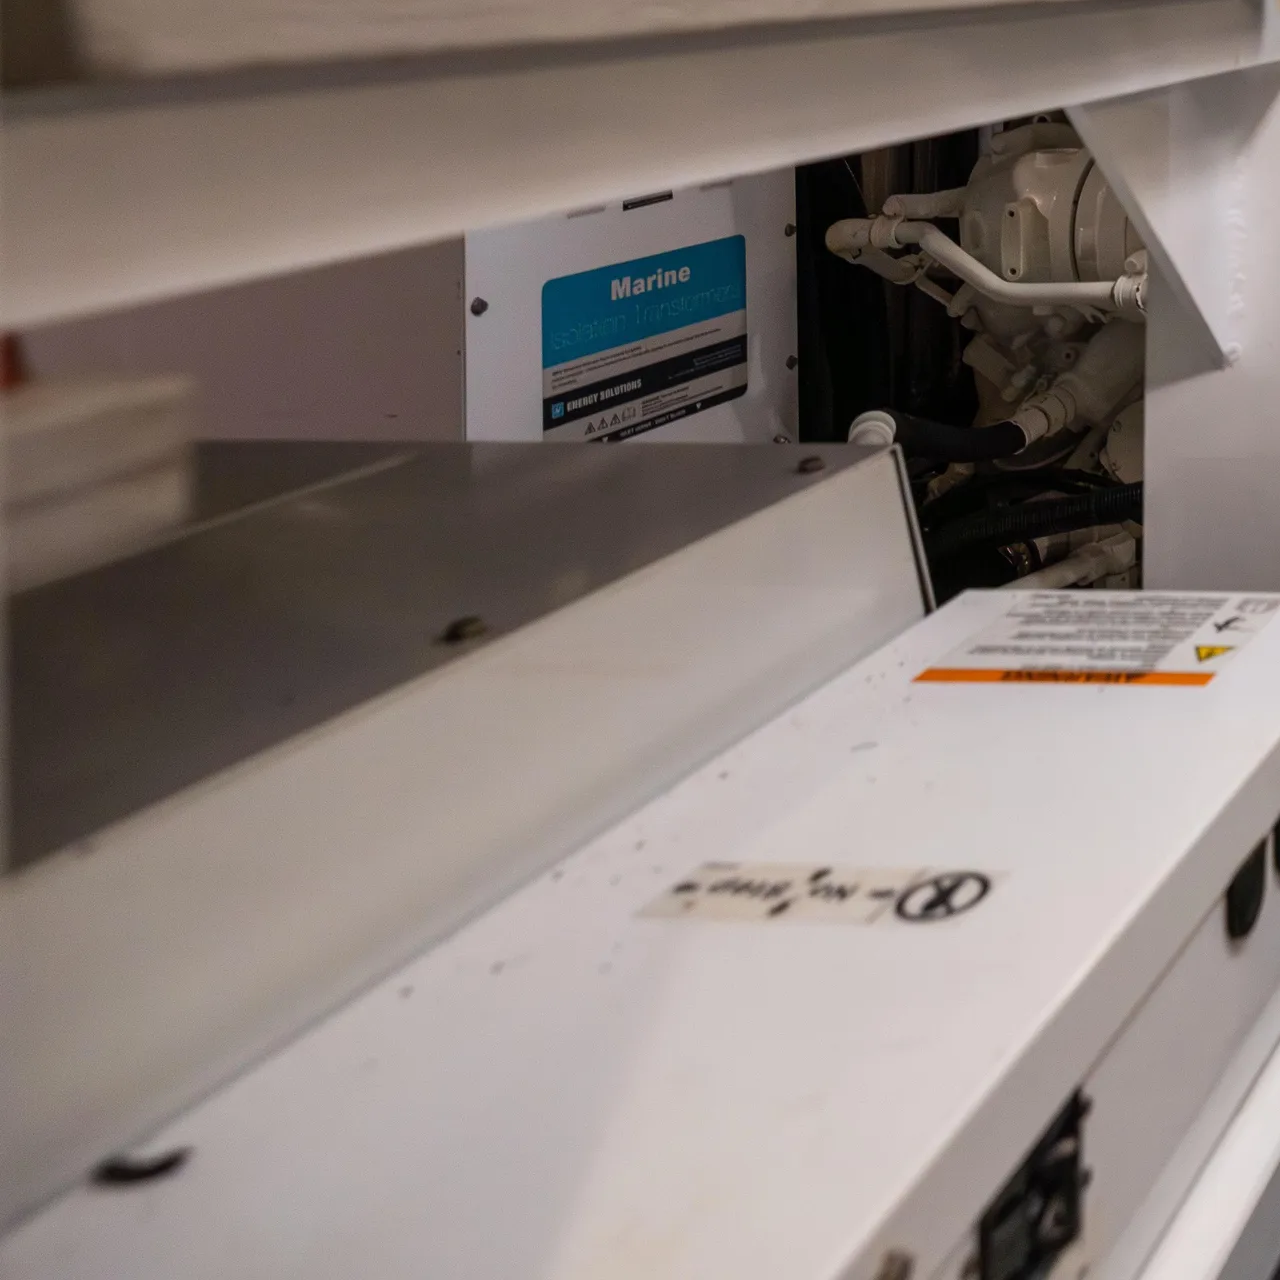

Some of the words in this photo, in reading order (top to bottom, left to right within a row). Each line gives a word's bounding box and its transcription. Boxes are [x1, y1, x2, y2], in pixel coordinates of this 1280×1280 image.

[610, 265, 691, 301] Marine
[566, 392, 599, 413] ENERGY
[599, 377, 643, 403] SOLUTIONS
